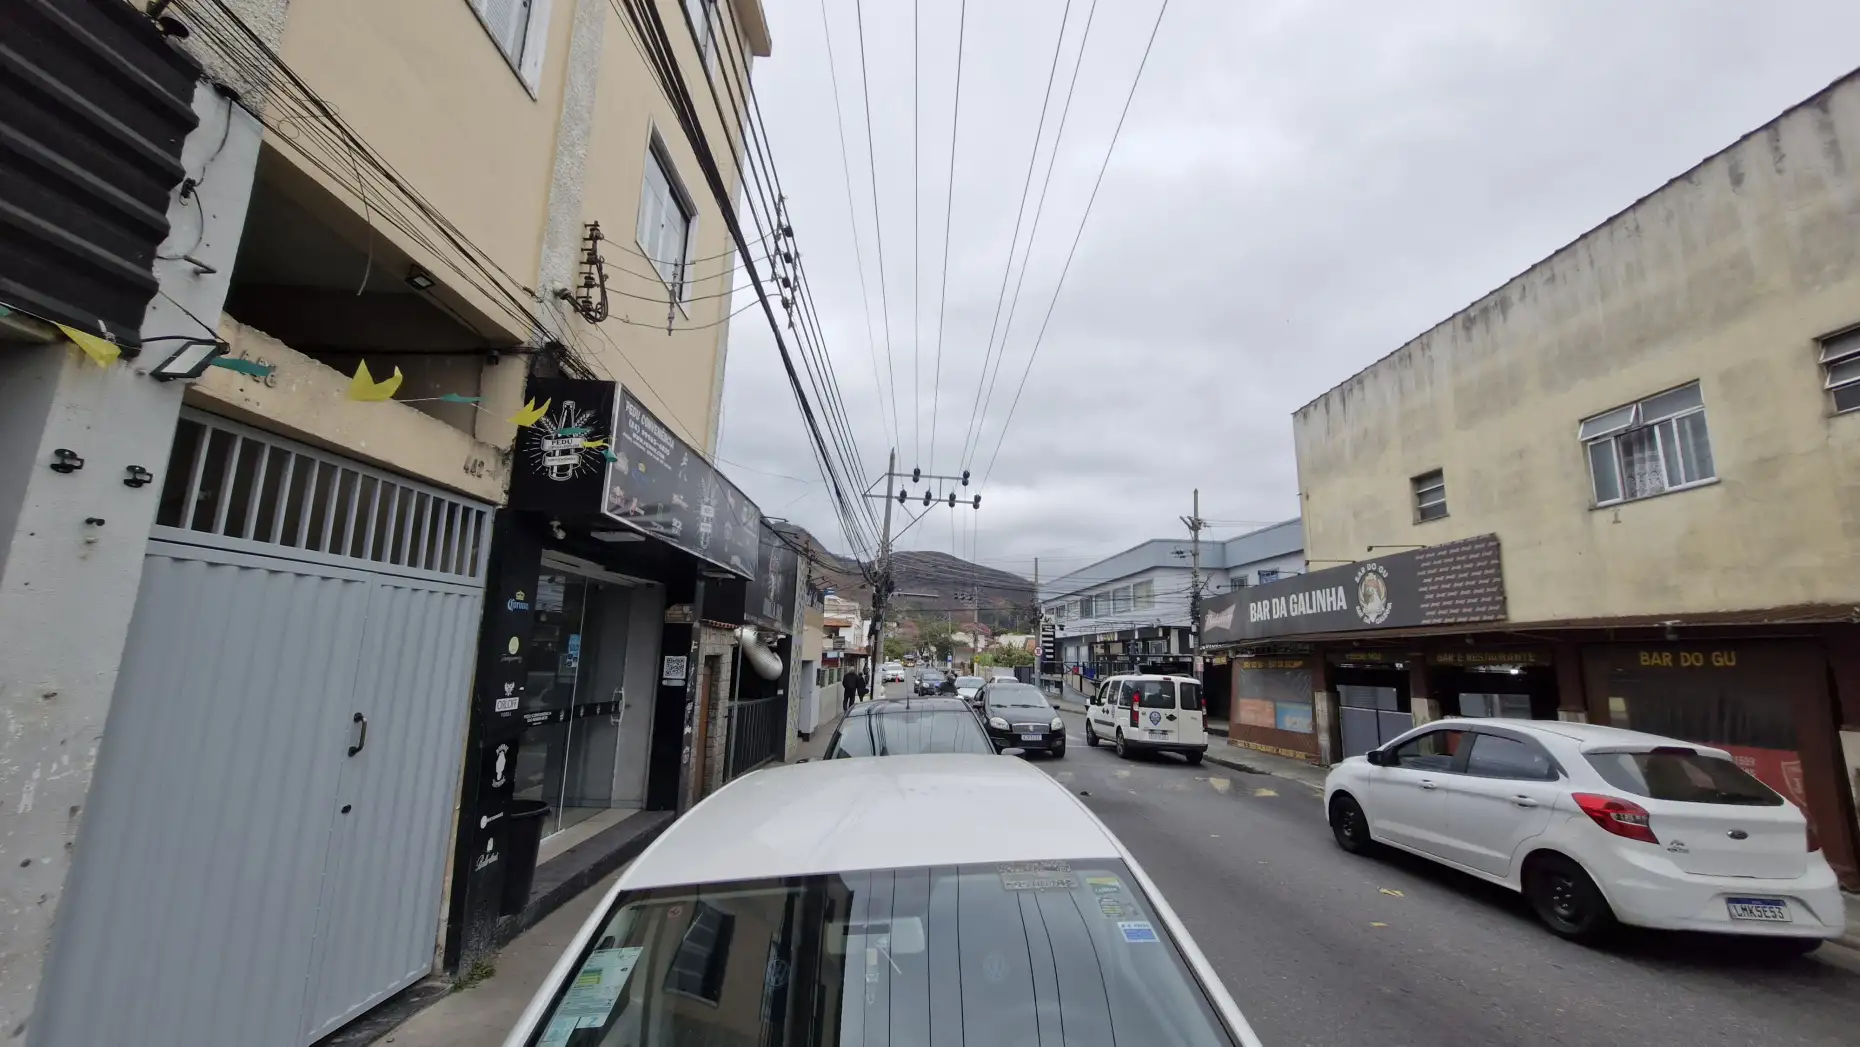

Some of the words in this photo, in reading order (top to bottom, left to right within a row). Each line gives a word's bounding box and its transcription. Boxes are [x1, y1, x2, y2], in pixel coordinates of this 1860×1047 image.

[625, 400, 641, 420] PEDU
[1355, 566, 1366, 584] BAR
[1366, 562, 1377, 571] DO
[1378, 565, 1389, 578] GU
[1250, 599, 1270, 623] BAR
[1272, 596, 1288, 619] DA
[1289, 585, 1348, 617] GALINHA
[1640, 651, 1673, 667] BAR
[1680, 652, 1704, 667] DO
[1711, 651, 1737, 667] GU
